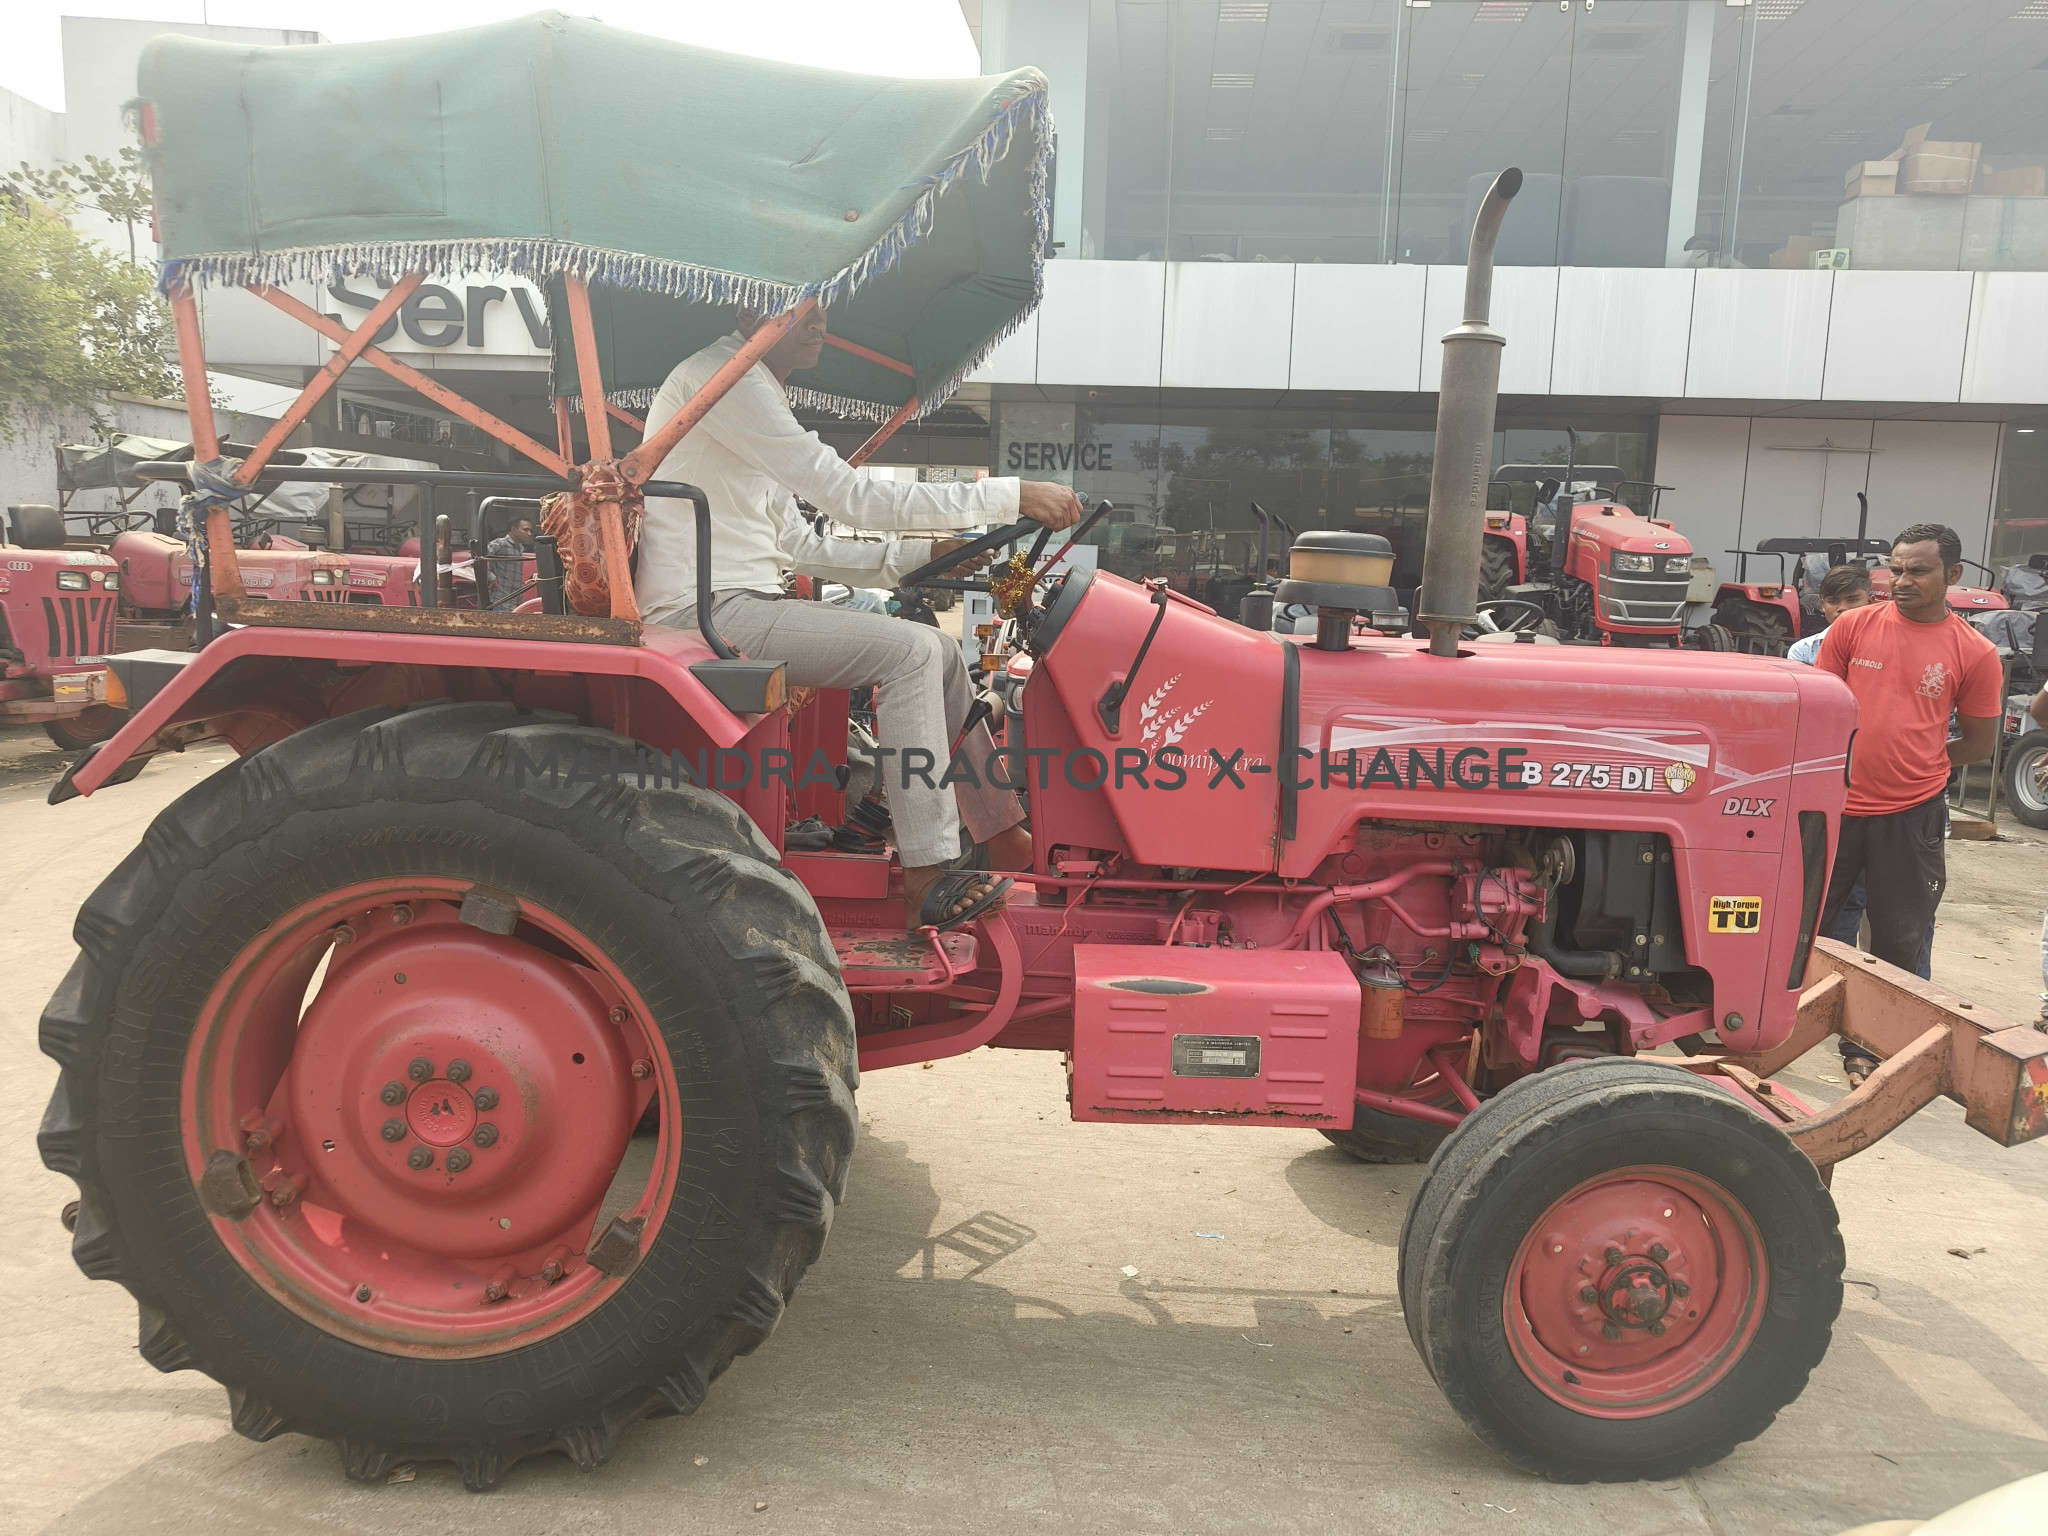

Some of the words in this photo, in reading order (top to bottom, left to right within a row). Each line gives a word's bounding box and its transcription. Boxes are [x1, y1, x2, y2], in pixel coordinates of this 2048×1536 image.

[1007, 441, 1113, 471] SERVICE
[1521, 761, 1543, 785] B
[1550, 763, 1611, 789] 275
[1619, 765, 1655, 791] DI
[1666, 766, 1694, 782] MKM
[1722, 797, 1776, 817] DLX
[1713, 900, 1731, 909] High
[1732, 900, 1760, 909] Torque
[1712, 911, 1759, 929] TU
[480, 1191, 738, 1425] APOLLO
